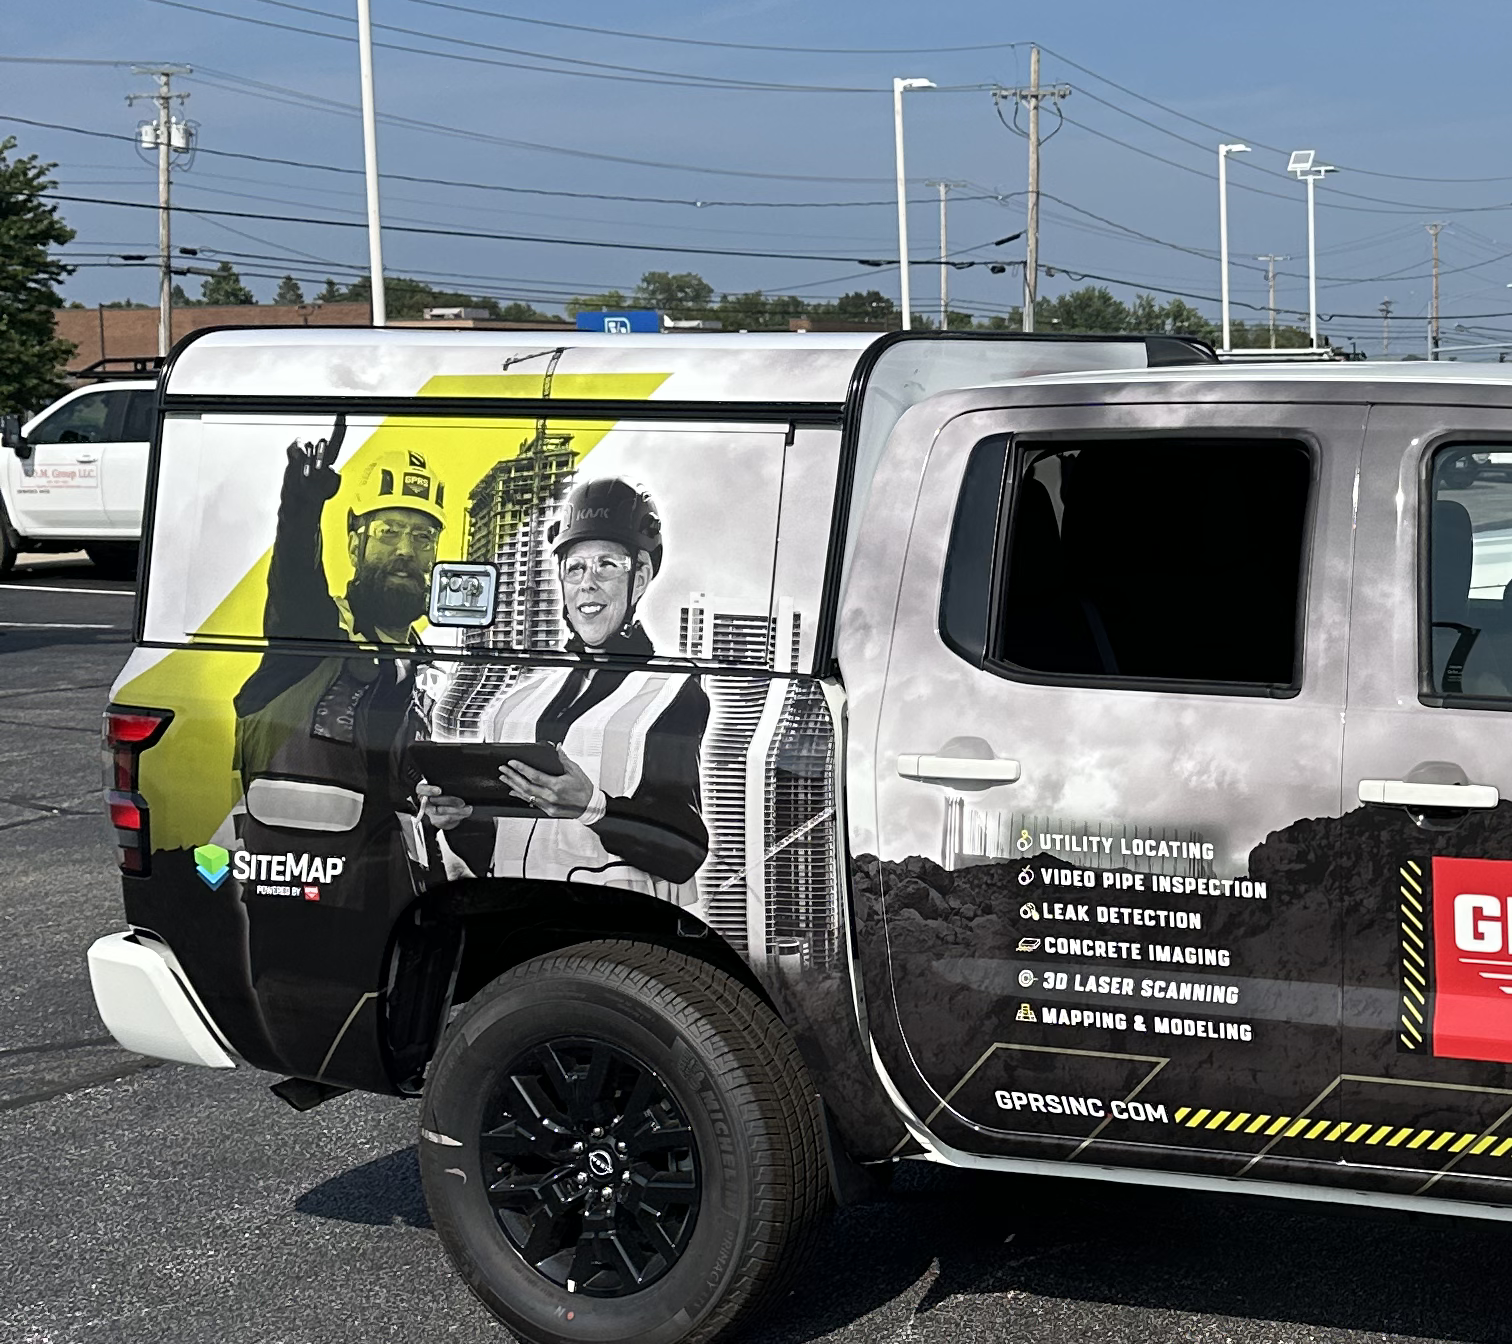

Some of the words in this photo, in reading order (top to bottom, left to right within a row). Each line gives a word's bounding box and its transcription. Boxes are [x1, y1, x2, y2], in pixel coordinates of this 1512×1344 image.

[1039, 833, 1112, 854] UTILITY
[1120, 838, 1214, 860] LOCATING
[1041, 868, 1096, 888] VIDEO
[1103, 872, 1145, 891] PIPE
[1152, 873, 1267, 899] INSPECTION
[1043, 902, 1089, 921] LEAK
[1097, 907, 1202, 929] DETECTION
[1044, 937, 1141, 960] CONCRETE
[1148, 945, 1230, 967] IMAGING
[1043, 972, 1067, 990] 3D
[1074, 976, 1134, 997] LASER
[1141, 980, 1239, 1004] SCANNING
[1042, 1008, 1127, 1030] MAPPING
[1134, 1016, 1146, 1032] &
[1155, 1018, 1252, 1041] MODELING
[995, 1090, 1168, 1123] GPRSINC.COM
